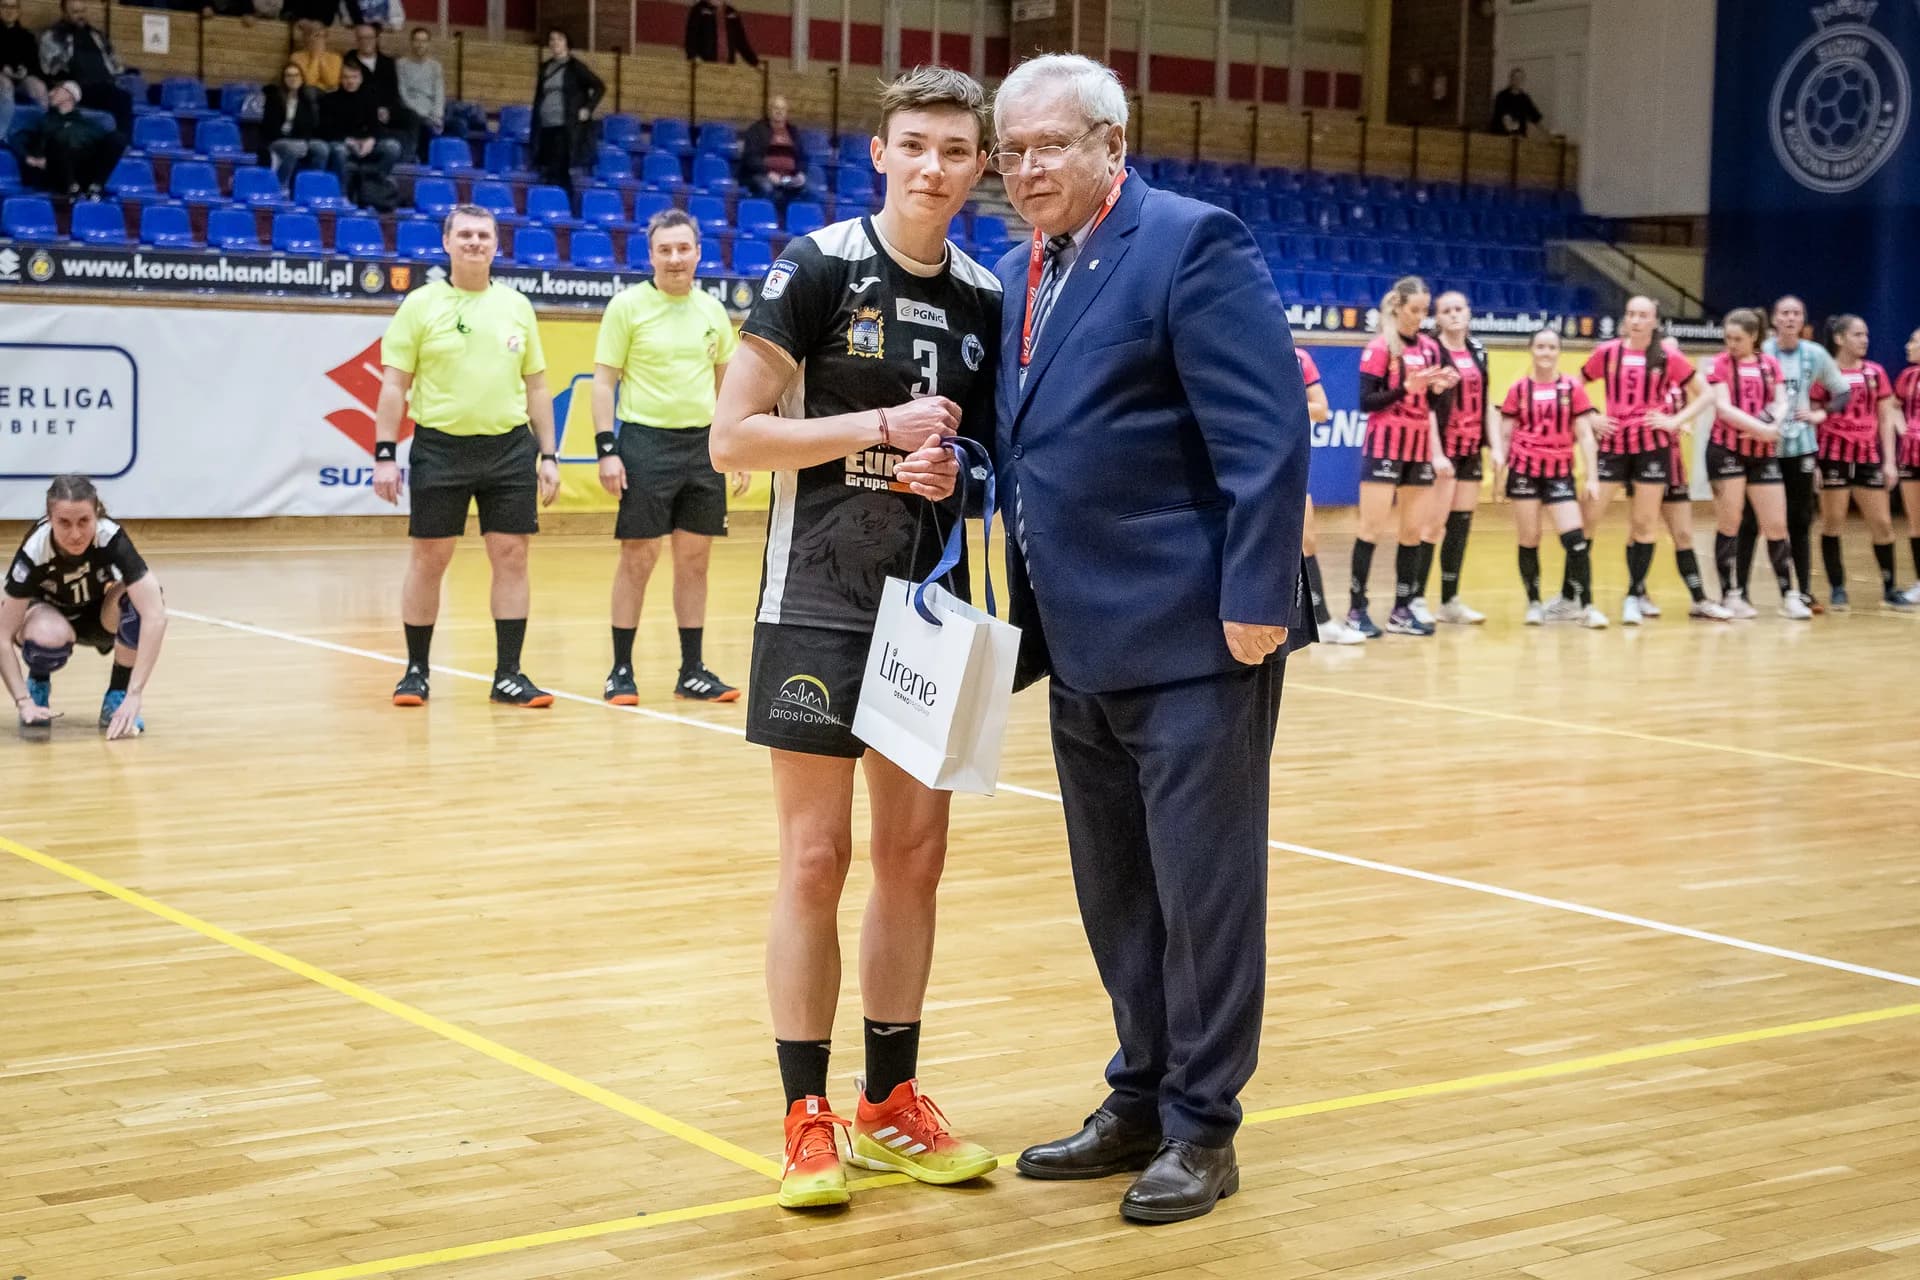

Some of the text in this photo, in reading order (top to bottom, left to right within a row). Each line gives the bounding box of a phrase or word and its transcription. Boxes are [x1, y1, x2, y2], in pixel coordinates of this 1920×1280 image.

[62, 254, 354, 292] www.koronahandball.pl
[911, 339, 938, 400] 3
[0, 419, 76, 435] BIET
[319, 467, 404, 486] SUZ
[845, 473, 889, 491] Grupa
[71, 577, 90, 604] 11
[879, 641, 937, 707] Lirene
